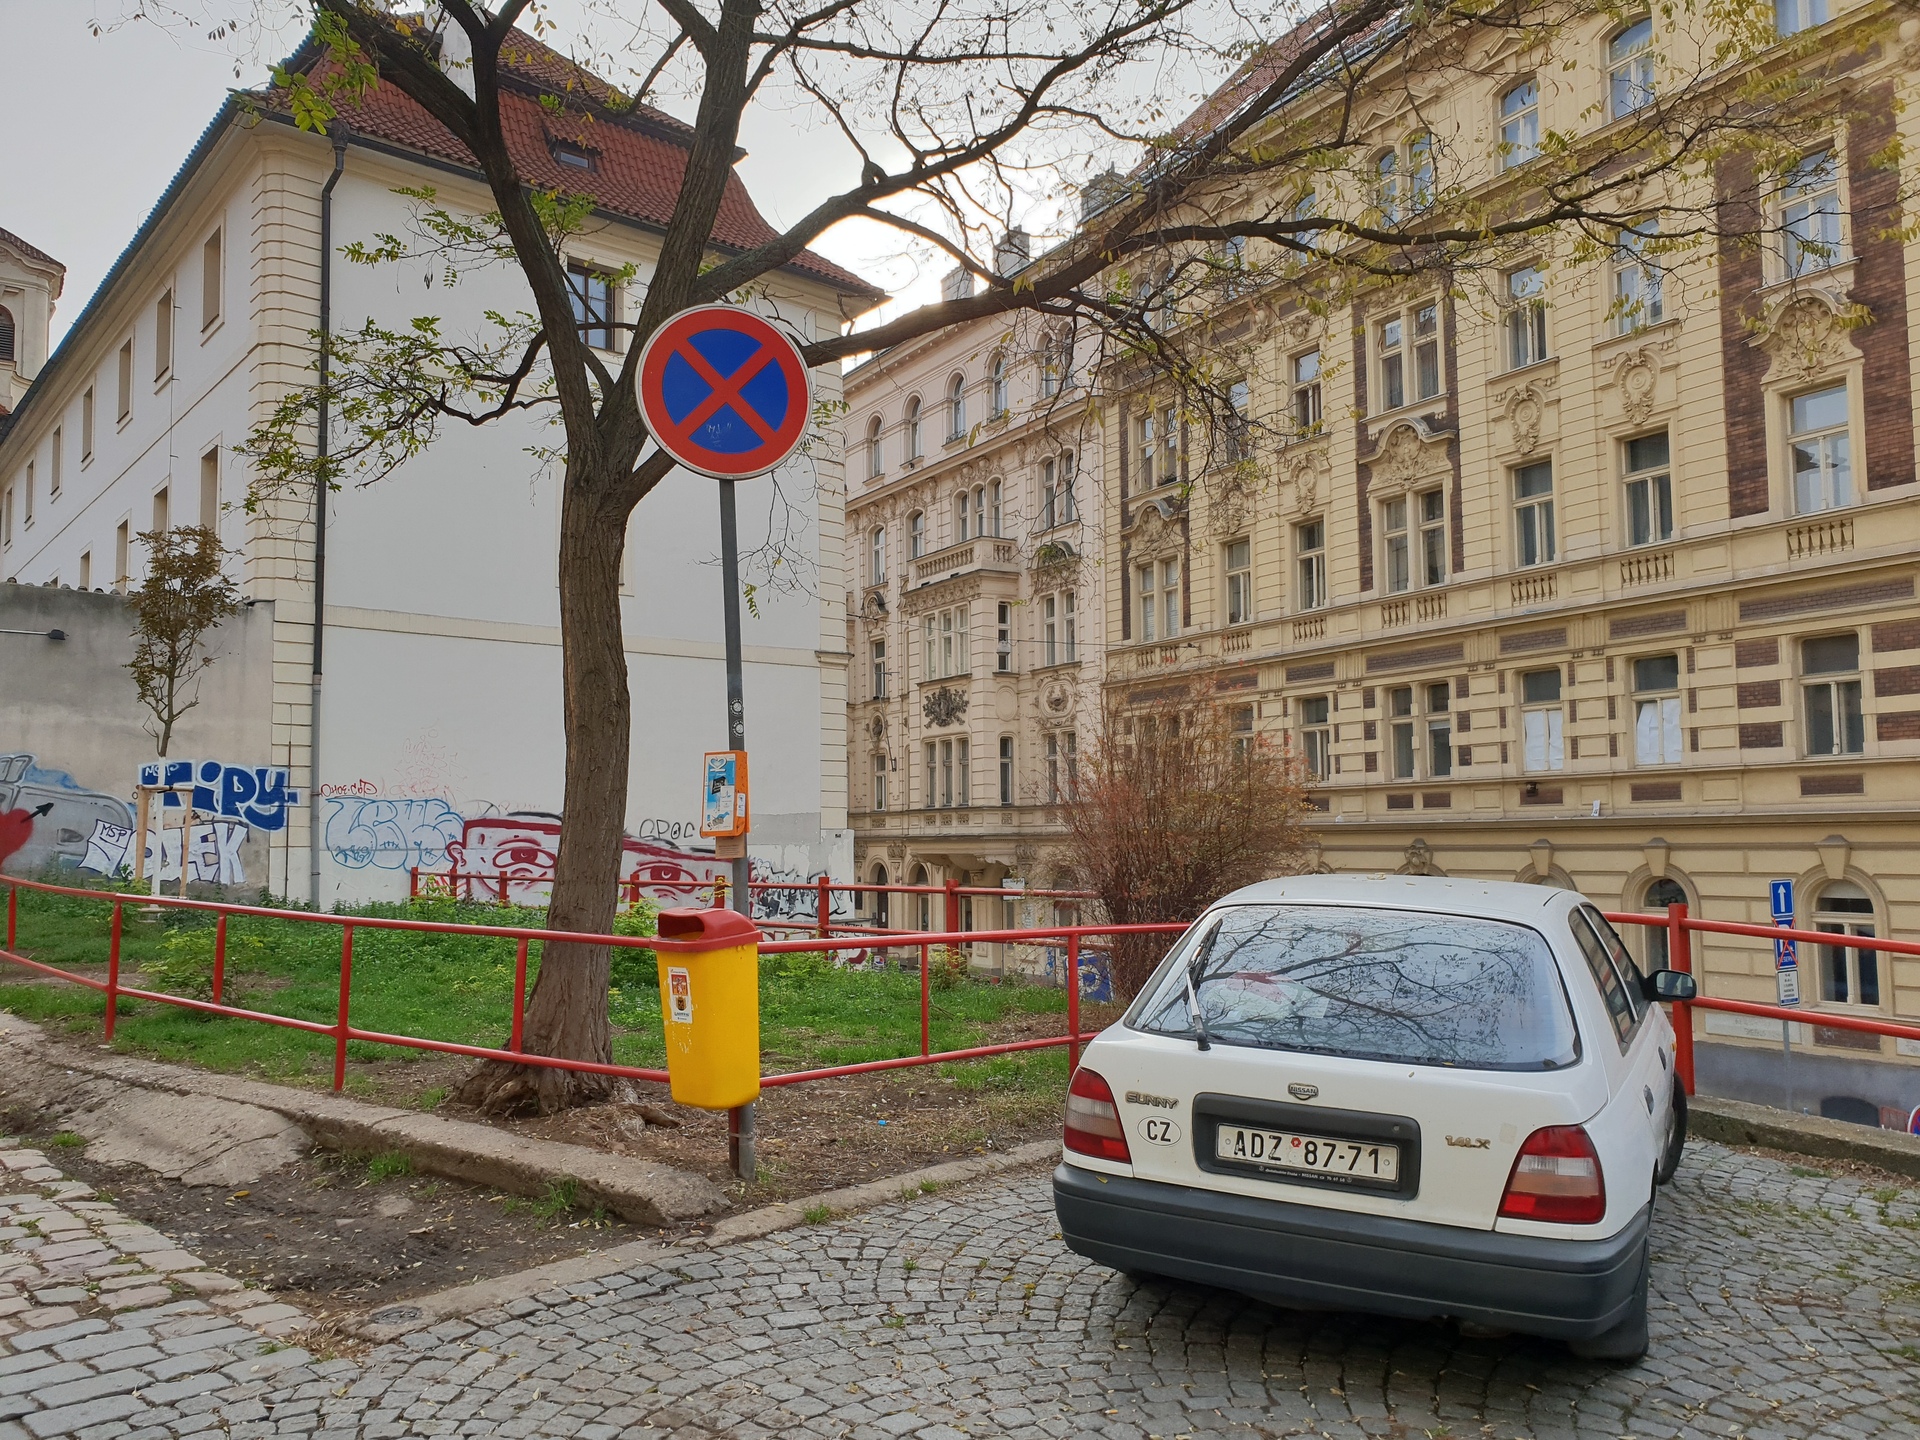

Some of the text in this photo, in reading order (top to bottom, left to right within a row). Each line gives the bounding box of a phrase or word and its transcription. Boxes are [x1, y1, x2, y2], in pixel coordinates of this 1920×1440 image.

[1125, 1091, 1180, 1110] SUNNY
[1146, 1119, 1172, 1143] CZ
[1233, 1130, 1380, 1175] ADZ 87-71
